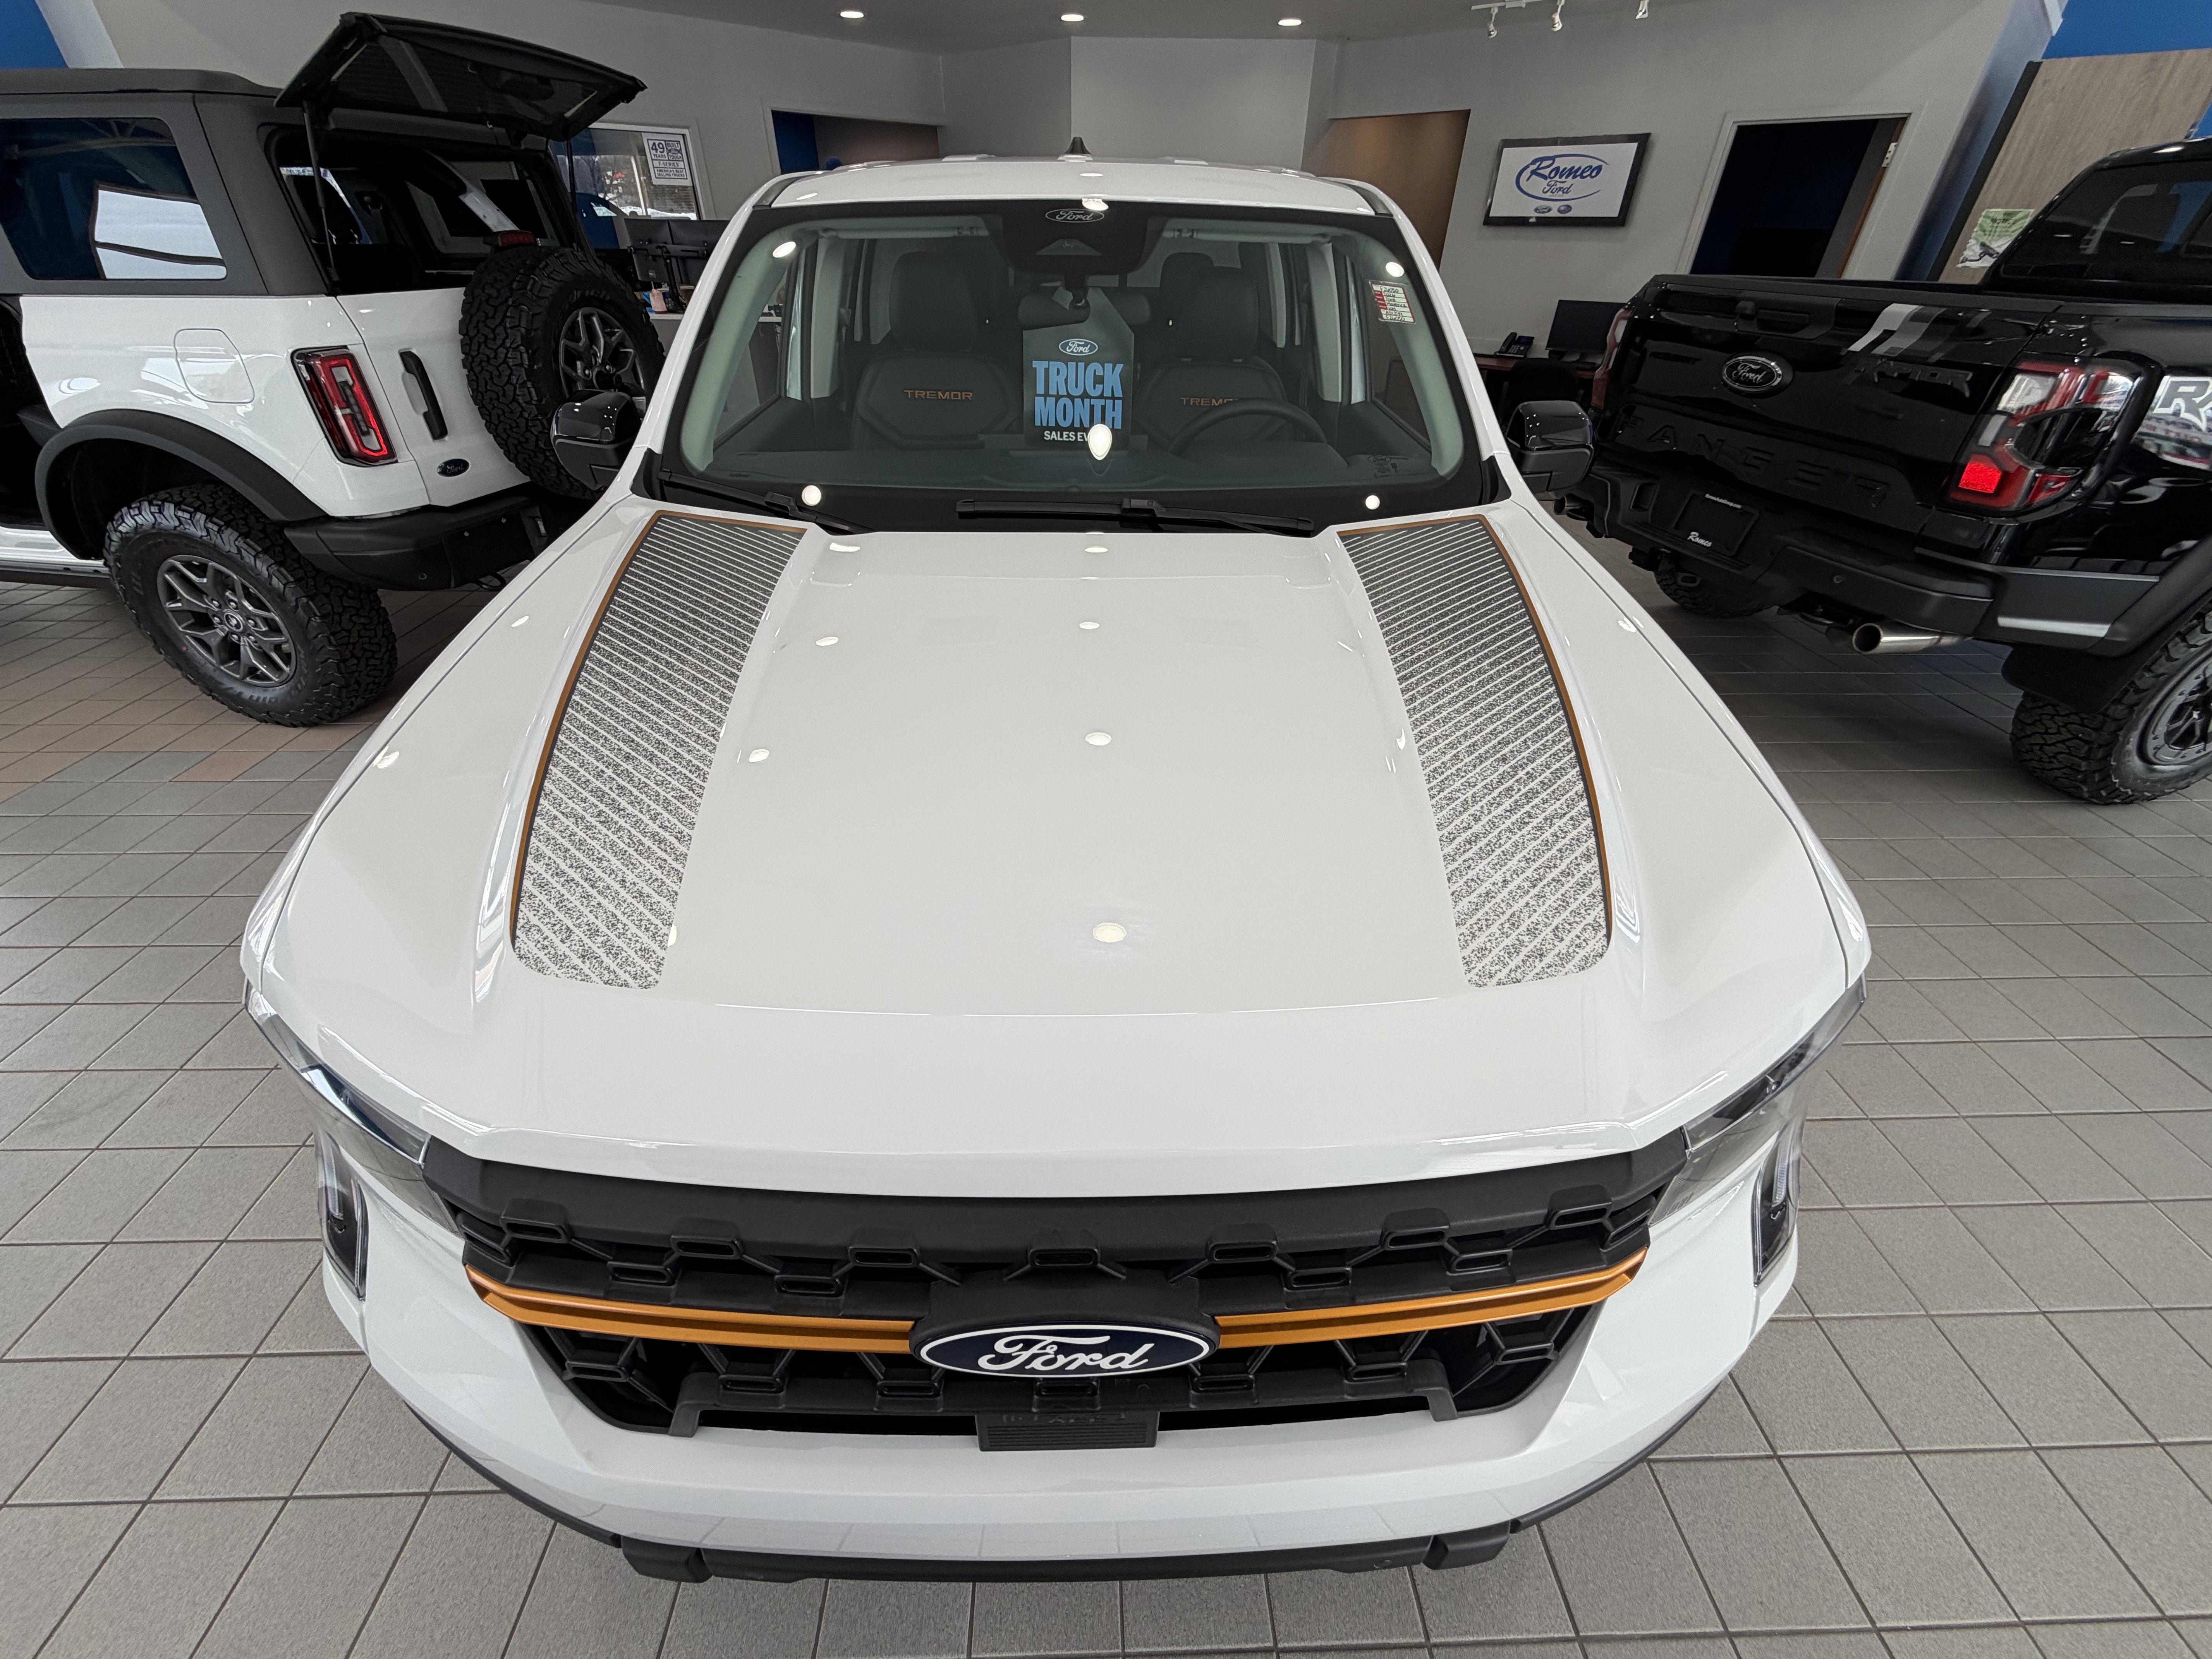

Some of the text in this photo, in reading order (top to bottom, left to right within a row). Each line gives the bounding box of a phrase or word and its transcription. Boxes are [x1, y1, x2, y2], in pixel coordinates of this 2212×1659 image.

[651, 142, 665, 153] 49
[1526, 156, 1602, 182] Romeo
[1542, 180, 1573, 194] Ford
[1056, 210, 1094, 220] Ford
[1066, 341, 1090, 353] Ford
[1032, 361, 1124, 397] TRUCK
[1732, 362, 1767, 384] Ford
[903, 390, 973, 400] TREMOR
[1180, 397, 1238, 406] TREM
[1035, 397, 1122, 429] MONTH
[1044, 431, 1076, 441] SALES
[1687, 531, 1713, 547] Romeo
[978, 1334, 1155, 1370] Ford
